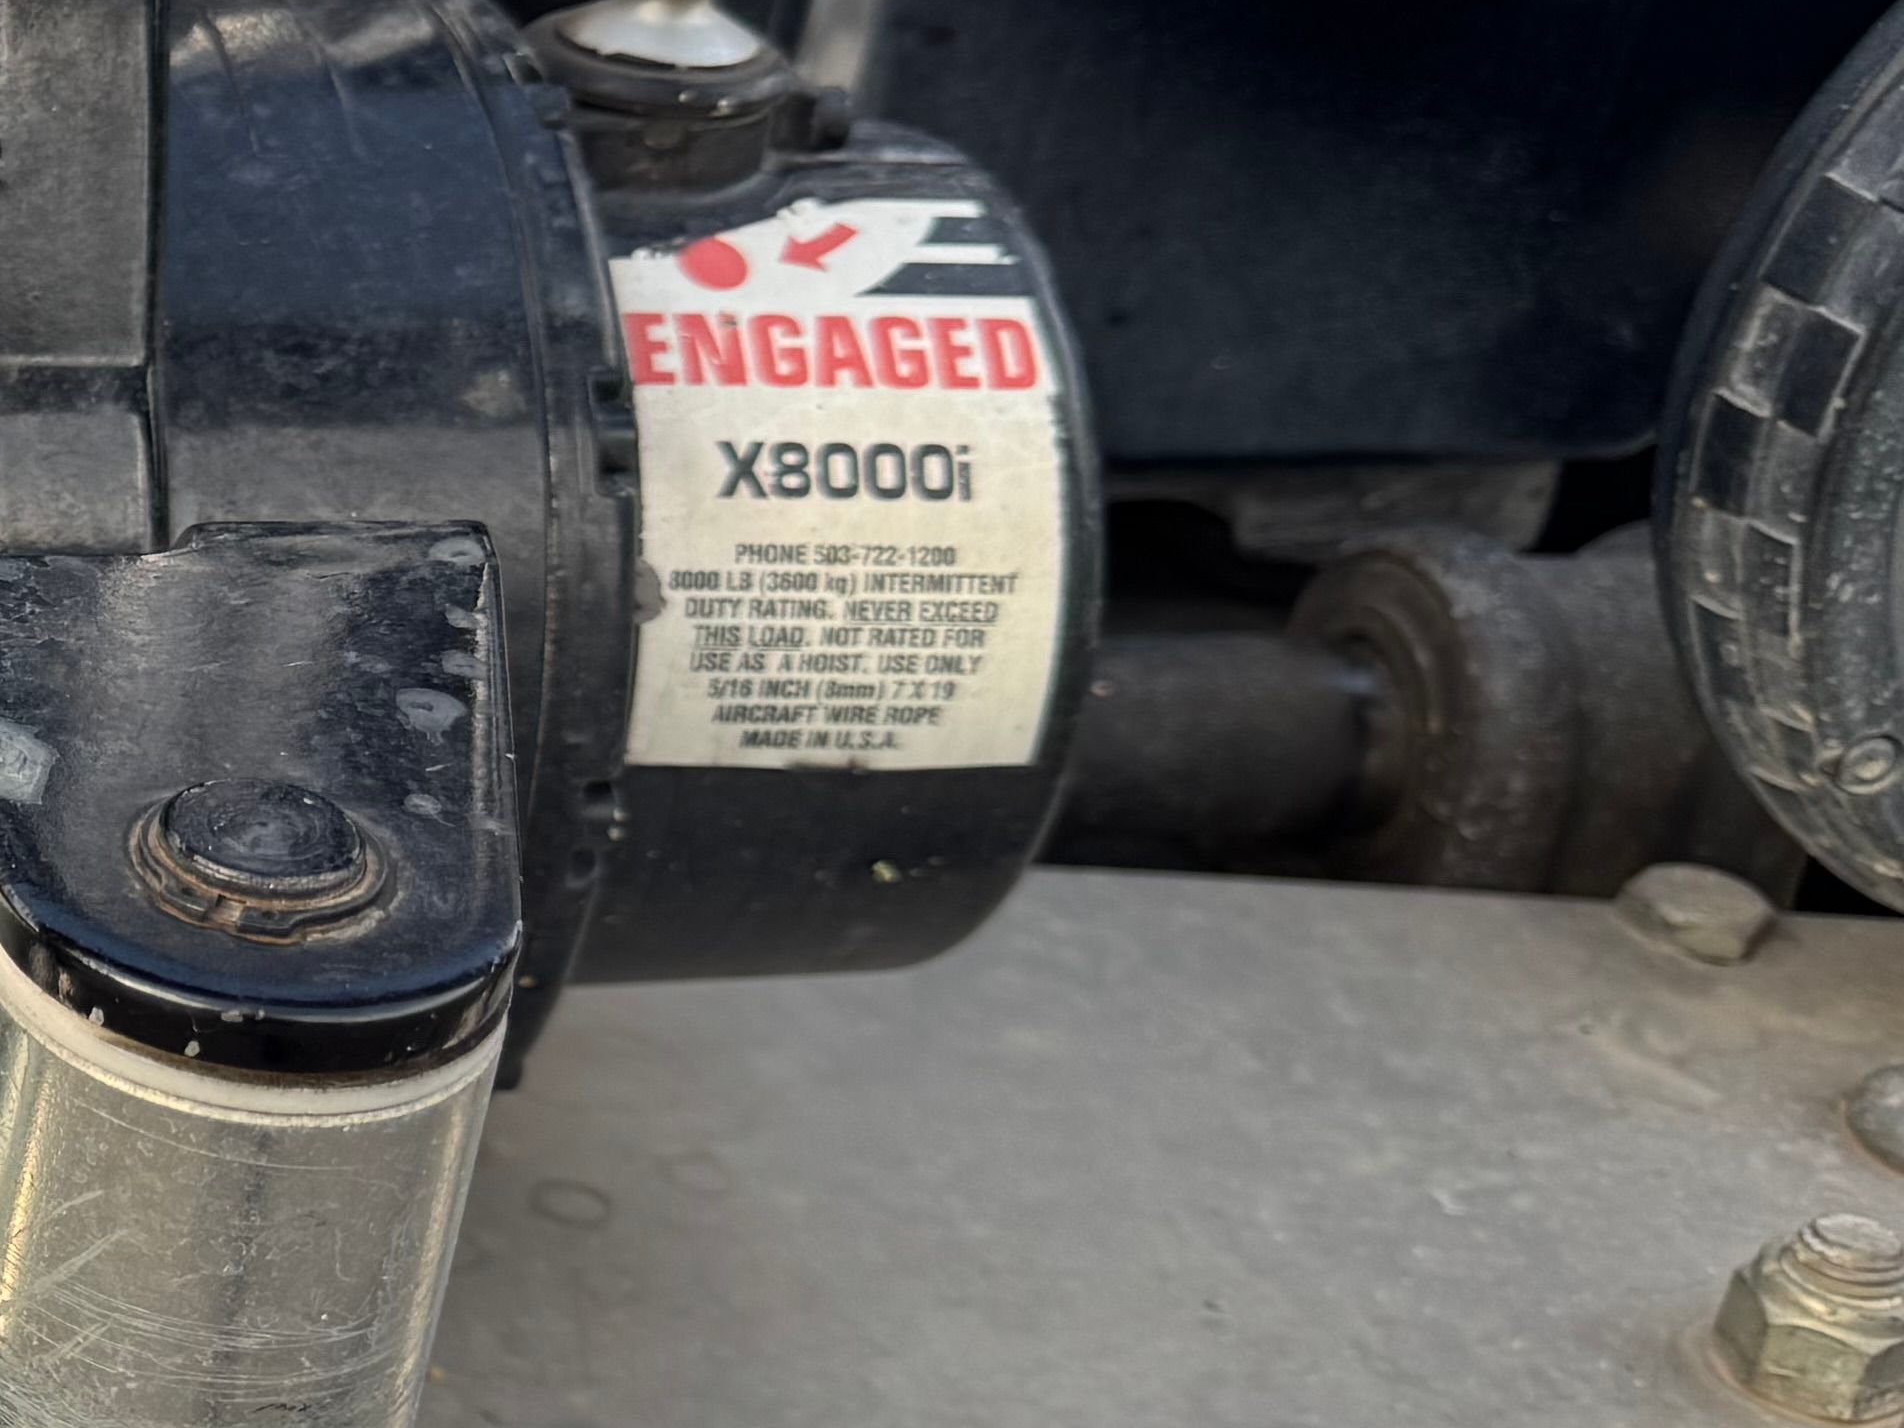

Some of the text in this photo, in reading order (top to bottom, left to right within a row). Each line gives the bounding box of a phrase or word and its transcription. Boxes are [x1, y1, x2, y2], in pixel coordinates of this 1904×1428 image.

[623, 312, 1038, 390] ENGAGED
[715, 440, 973, 502] X8000i
[735, 544, 957, 567] PHONE 503-722-1200
[726, 573, 751, 591] LB
[864, 573, 1018, 594] INTERMITTENT
[684, 598, 740, 619] DUTY
[845, 600, 912, 623] NEVER
[920, 601, 999, 623] EXCEED
[696, 626, 740, 649] THIS
[820, 627, 862, 647] NOT
[868, 627, 936, 647] RATED
[942, 628, 985, 647] FOR
[692, 652, 730, 672] USE
[736, 652, 765, 672] AS
[778, 652, 793, 672] A
[878, 653, 917, 672] USE
[925, 654, 982, 673] ONLY
[707, 678, 751, 698] 5/16
[758, 679, 810, 698] INCH
[892, 679, 904, 698] 7
[932, 680, 955, 699] 19
[712, 704, 942, 725] AIRCRAFT WIRE ROPE
[740, 731, 798, 749] MADE
[805, 731, 829, 748] IN
